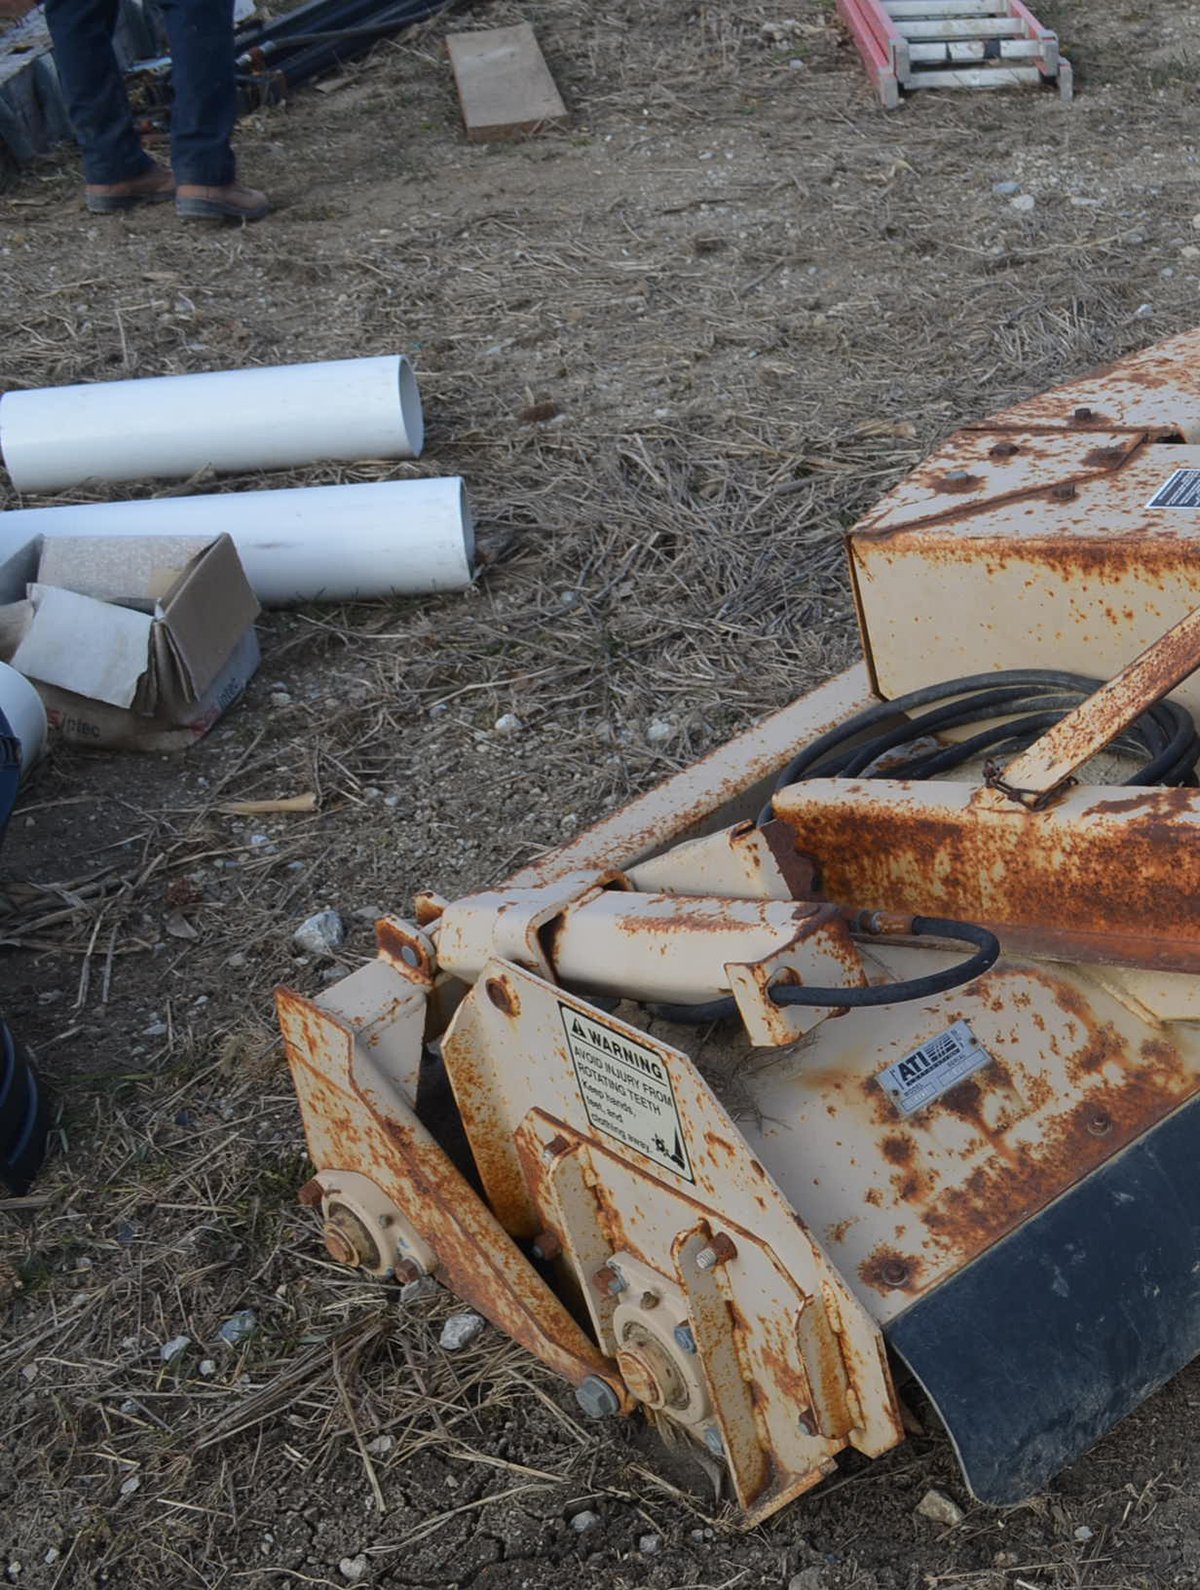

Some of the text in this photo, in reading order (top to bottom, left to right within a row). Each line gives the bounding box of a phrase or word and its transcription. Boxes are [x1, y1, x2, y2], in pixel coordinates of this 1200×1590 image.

[588, 1028, 663, 1080] WARNING
[898, 1050, 931, 1082] ATI
[574, 1046, 673, 1107] AVOID INJURY FROM
[577, 1062, 661, 1116] ROTATING TEETH
[582, 1079, 605, 1100] Keep
[591, 1113, 627, 1139] clothing
